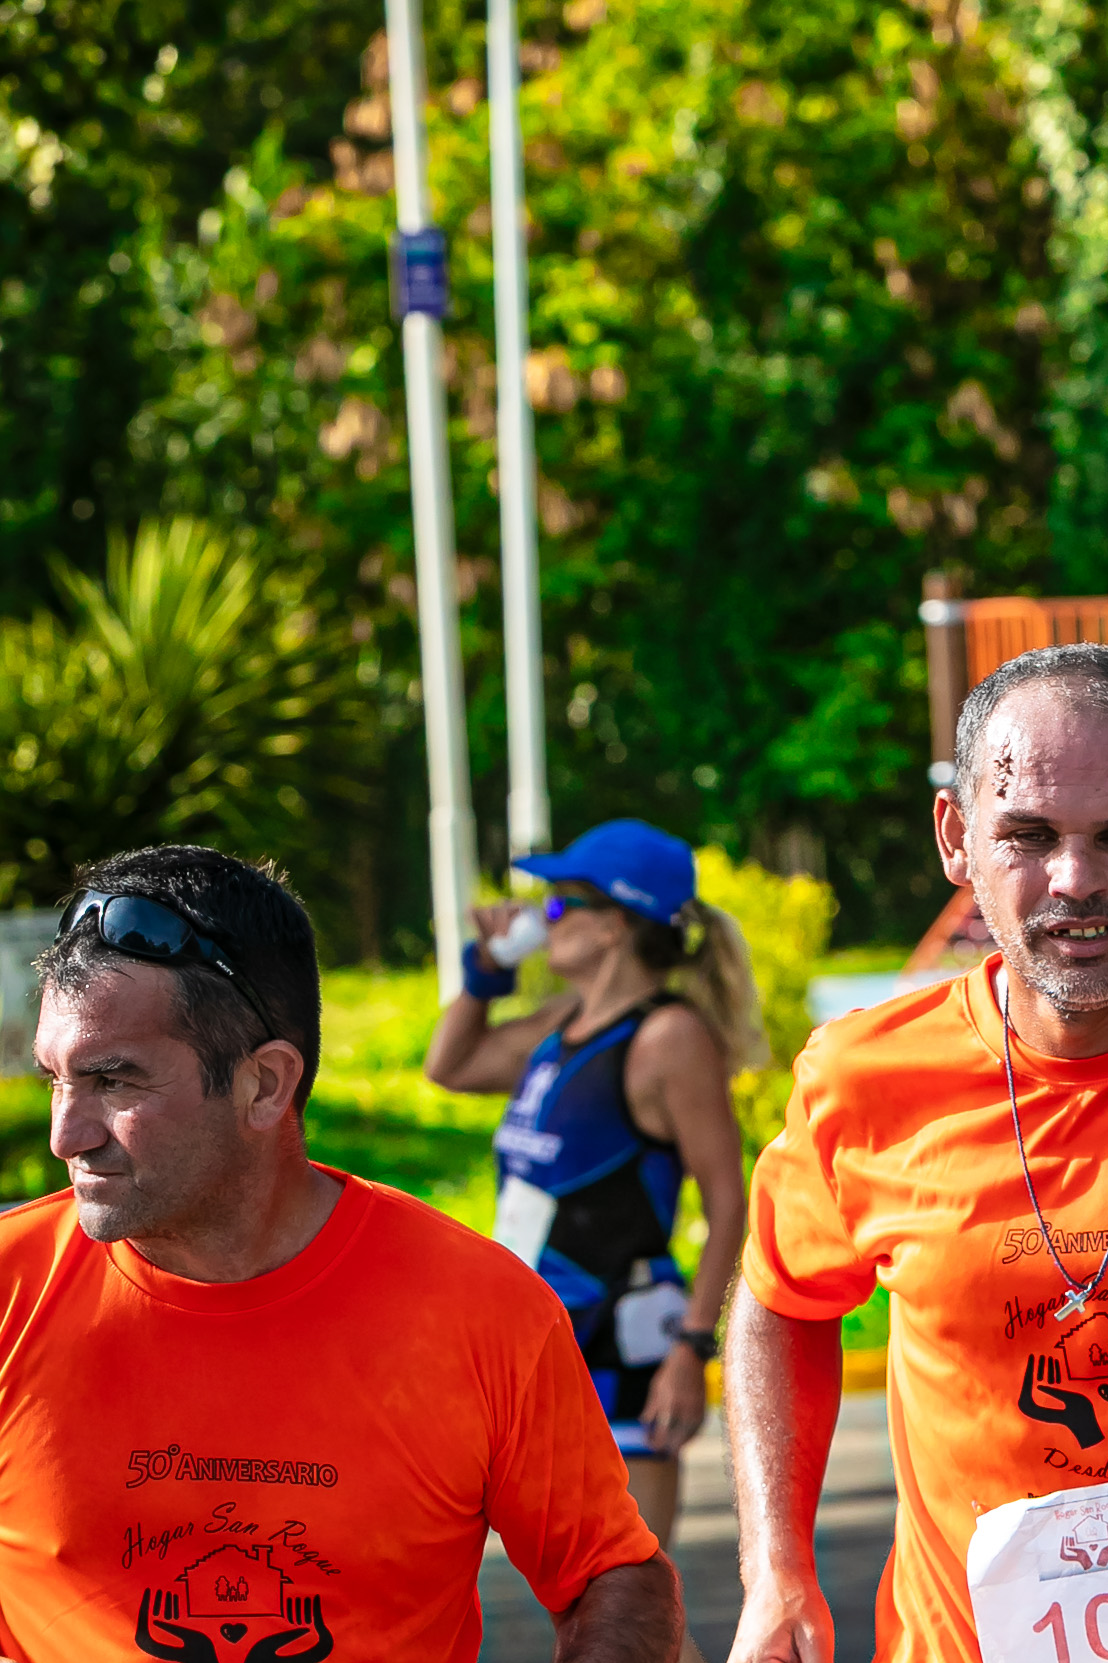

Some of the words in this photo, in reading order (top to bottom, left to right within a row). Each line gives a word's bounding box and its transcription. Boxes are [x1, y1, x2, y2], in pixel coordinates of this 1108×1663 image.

[121, 1522, 195, 1569] Hogar
[204, 1502, 259, 1535] San
[268, 1520, 341, 1576] Roque
